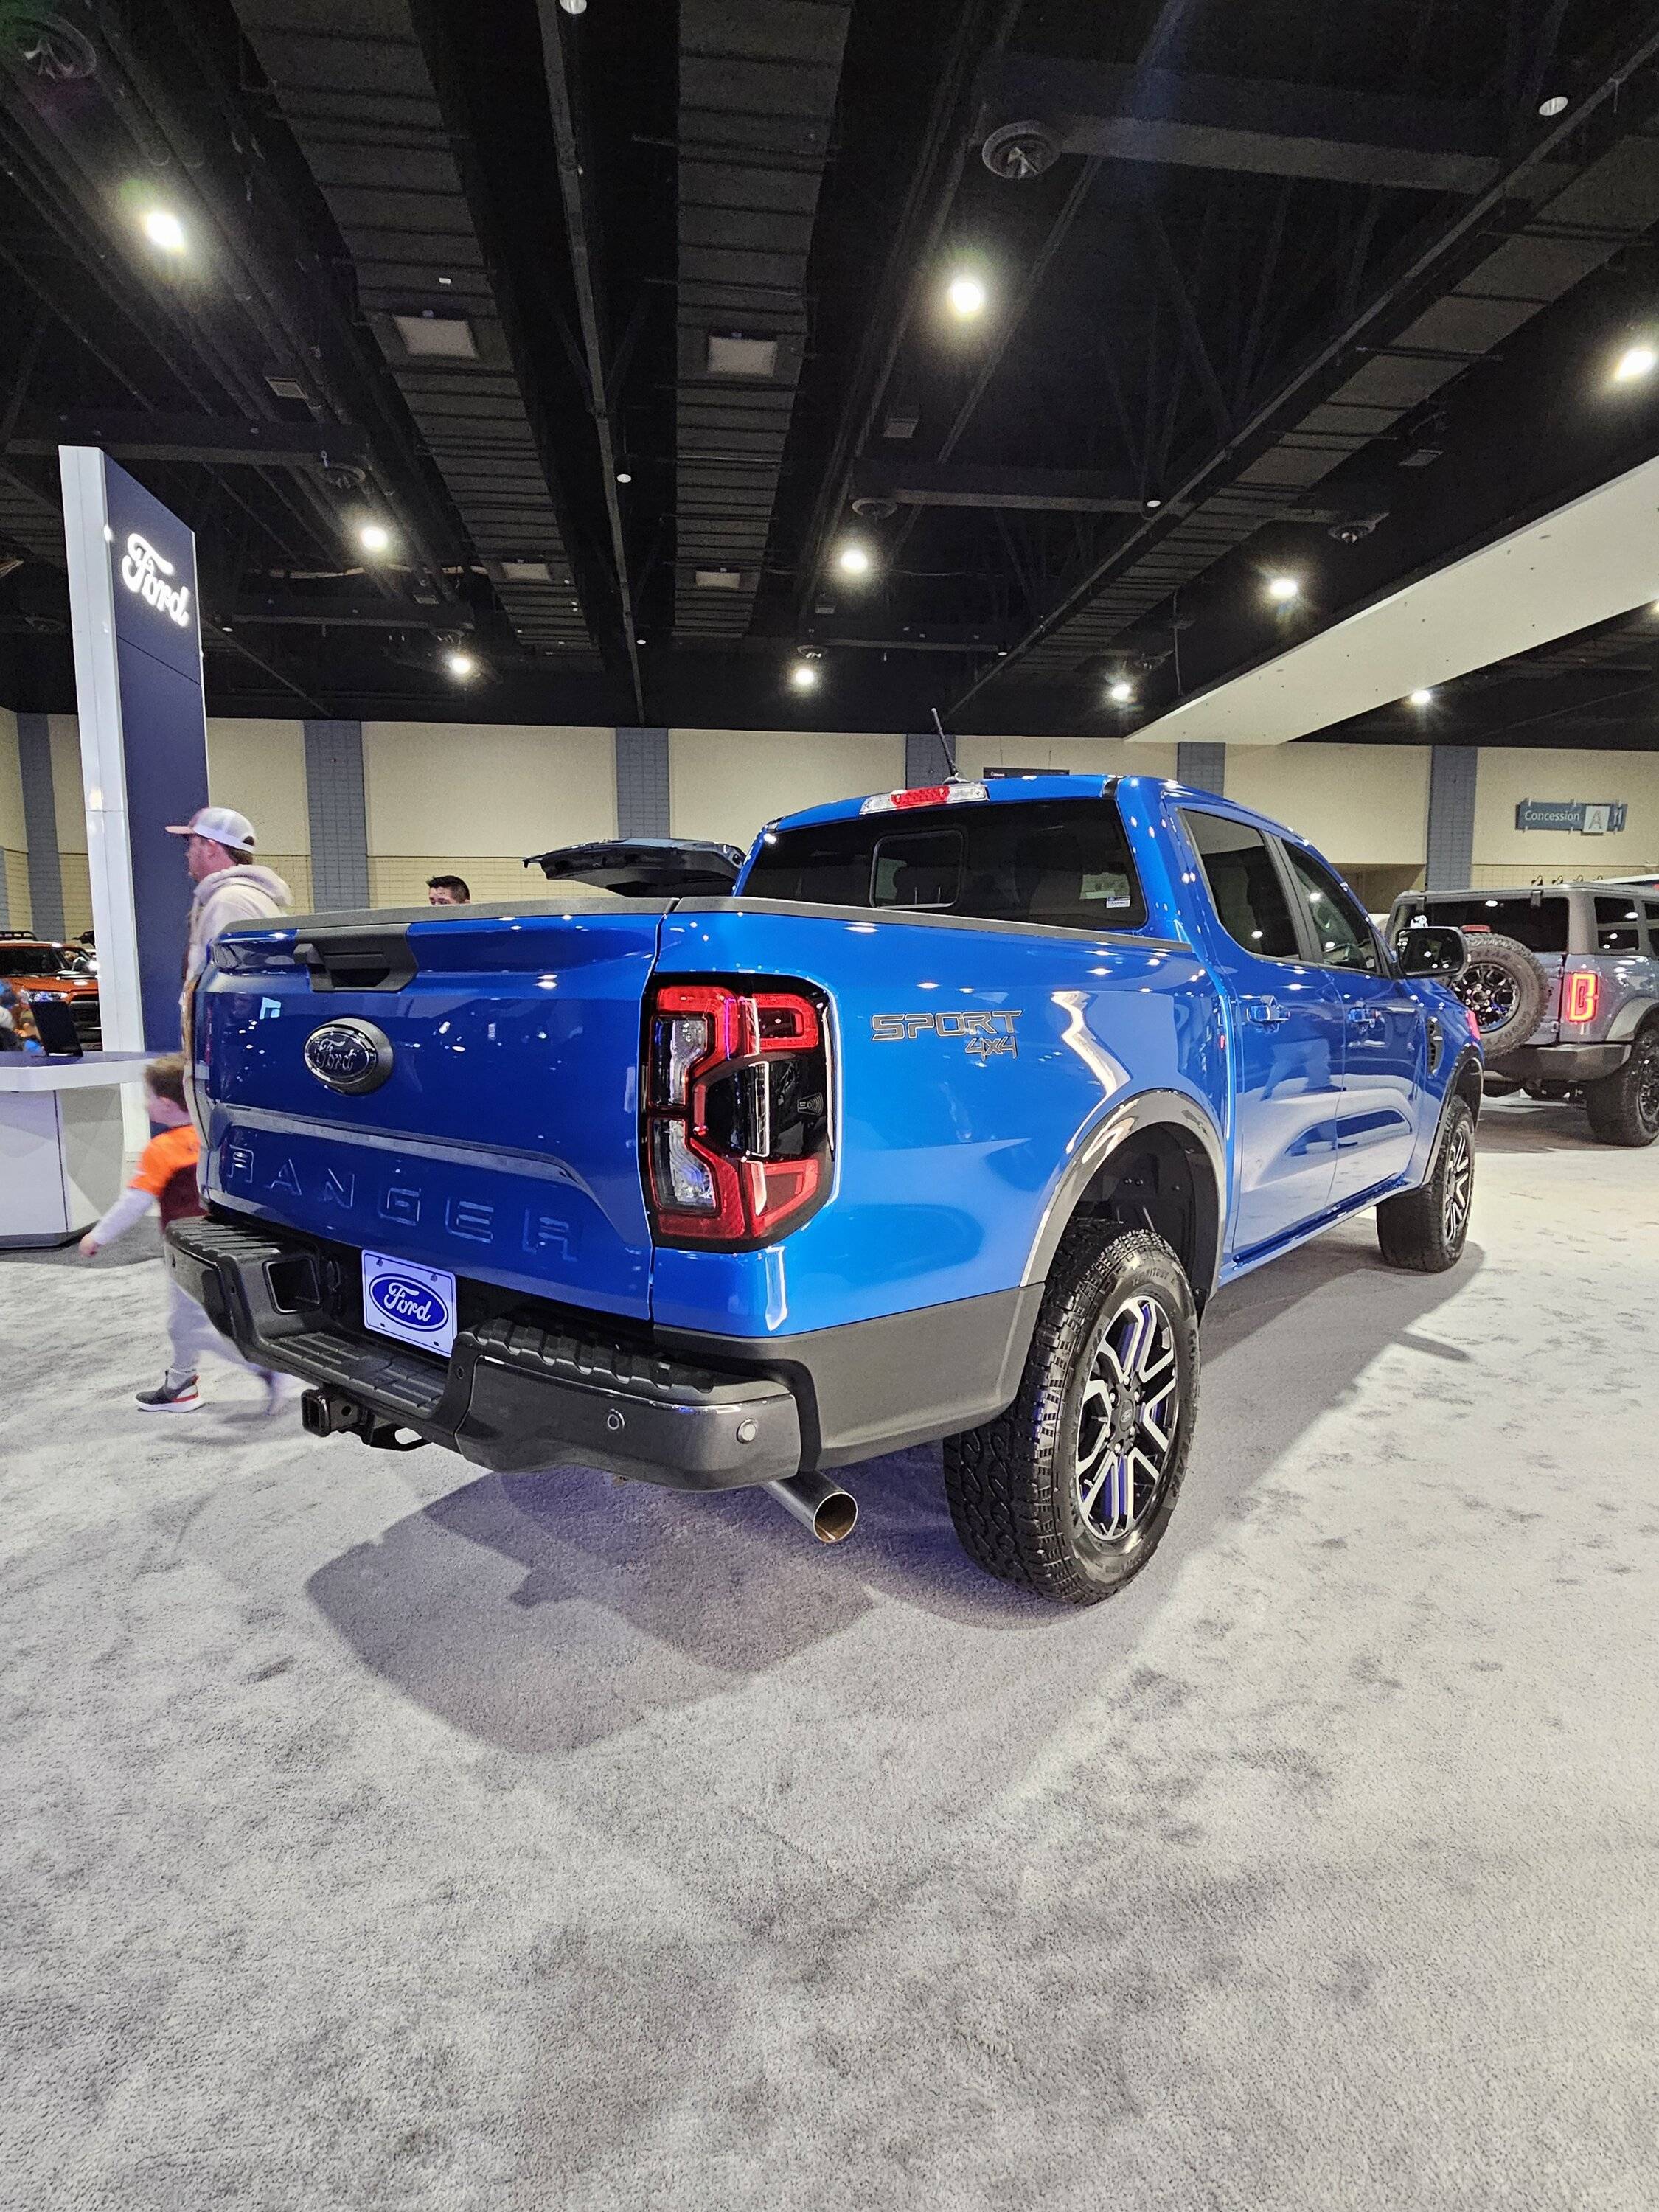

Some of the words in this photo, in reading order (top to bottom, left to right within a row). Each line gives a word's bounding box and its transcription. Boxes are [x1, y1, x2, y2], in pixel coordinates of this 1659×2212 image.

[121, 532, 190, 627] Ford
[1524, 810, 1580, 822] Concession
[1588, 810, 1604, 831] A
[871, 1010, 1023, 1041] SPORT
[315, 1037, 358, 1071] Ford
[964, 1036, 1018, 1062] 4x4
[220, 1144, 577, 1262] RANGER
[383, 1282, 433, 1322] Ford
